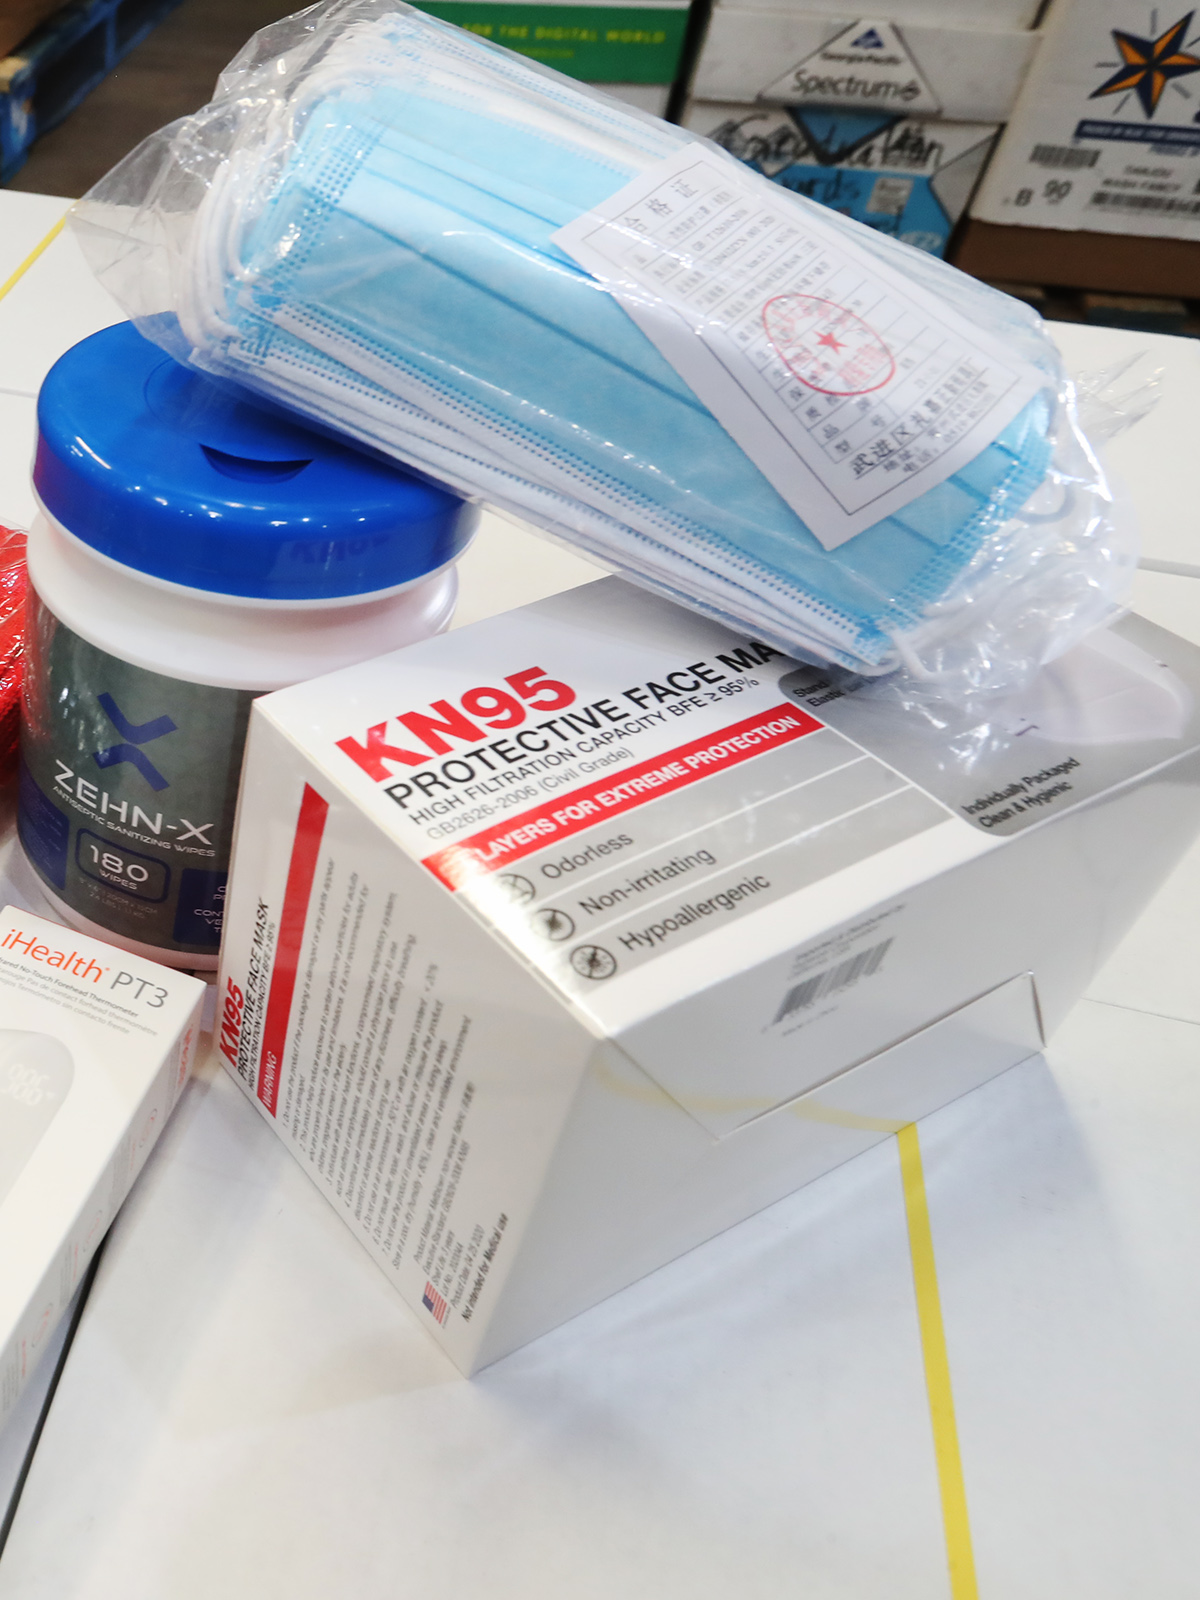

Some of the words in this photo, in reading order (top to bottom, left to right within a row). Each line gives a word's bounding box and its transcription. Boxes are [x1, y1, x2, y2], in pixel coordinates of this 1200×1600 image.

[499, 25, 528, 38] THE
[535, 26, 597, 41] DIGITAL
[606, 30, 665, 43] WORLD
[792, 67, 898, 97] Spectrum
[335, 666, 576, 783] KN95
[384, 698, 619, 809] PROTECTIVE
[623, 662, 726, 718] FACE
[409, 794, 460, 827] HIGH
[465, 748, 576, 800] FILTRATION
[577, 711, 666, 757] CAPACITY
[667, 693, 702, 718] BFE
[720, 675, 761, 698] 95%
[54, 759, 215, 845] ZEHN-X
[426, 785, 538, 840] GB2626-2006
[539, 765, 578, 795] (Civil
[578, 746, 635, 778] Grade)
[475, 817, 557, 861] LAYERS
[557, 797, 601, 826] FOR
[602, 760, 689, 808] EXTREME
[688, 714, 801, 771] PROTECTION
[962, 782, 1029, 815] Individually
[1022, 756, 1080, 788] Packaged
[979, 807, 1016, 828] Clean
[1012, 801, 1027, 813] &
[1021, 781, 1073, 808] Hygienic
[52, 786, 106, 826] ANTISEPTIC
[106, 820, 171, 850] SANITIZING
[173, 843, 216, 858] WIPES
[89, 844, 149, 882] 180
[99, 868, 137, 891] WIPES
[540, 830, 635, 880] Odorless
[579, 848, 717, 915] Non-irritating
[617, 873, 772, 952] Hypoallergenic
[0, 929, 103, 983] iHealth
[110, 970, 169, 1008] PT3
[20, 965, 54, 983] No-Touch
[53, 979, 89, 998] Forehead
[89, 993, 139, 1018] Thermometer
[40, 982, 50, 990] de
[50, 986, 78, 1003] contact
[236, 988, 256, 1082] PROTECTIVE
[247, 947, 263, 996] FACE
[255, 896, 271, 949] MASK
[255, 965, 268, 1016] CAPACITY
[73, 1007, 106, 1025] contacto
[218, 976, 245, 1068] KN95
[250, 1011, 264, 1066] FILTRATION
[261, 1050, 278, 1110] WARNING
[482, 1225, 502, 1264] Medical
[496, 1209, 508, 1232] use
[466, 1269, 485, 1310] intended
[478, 1257, 490, 1277] for
[461, 1302, 473, 1324] Not
